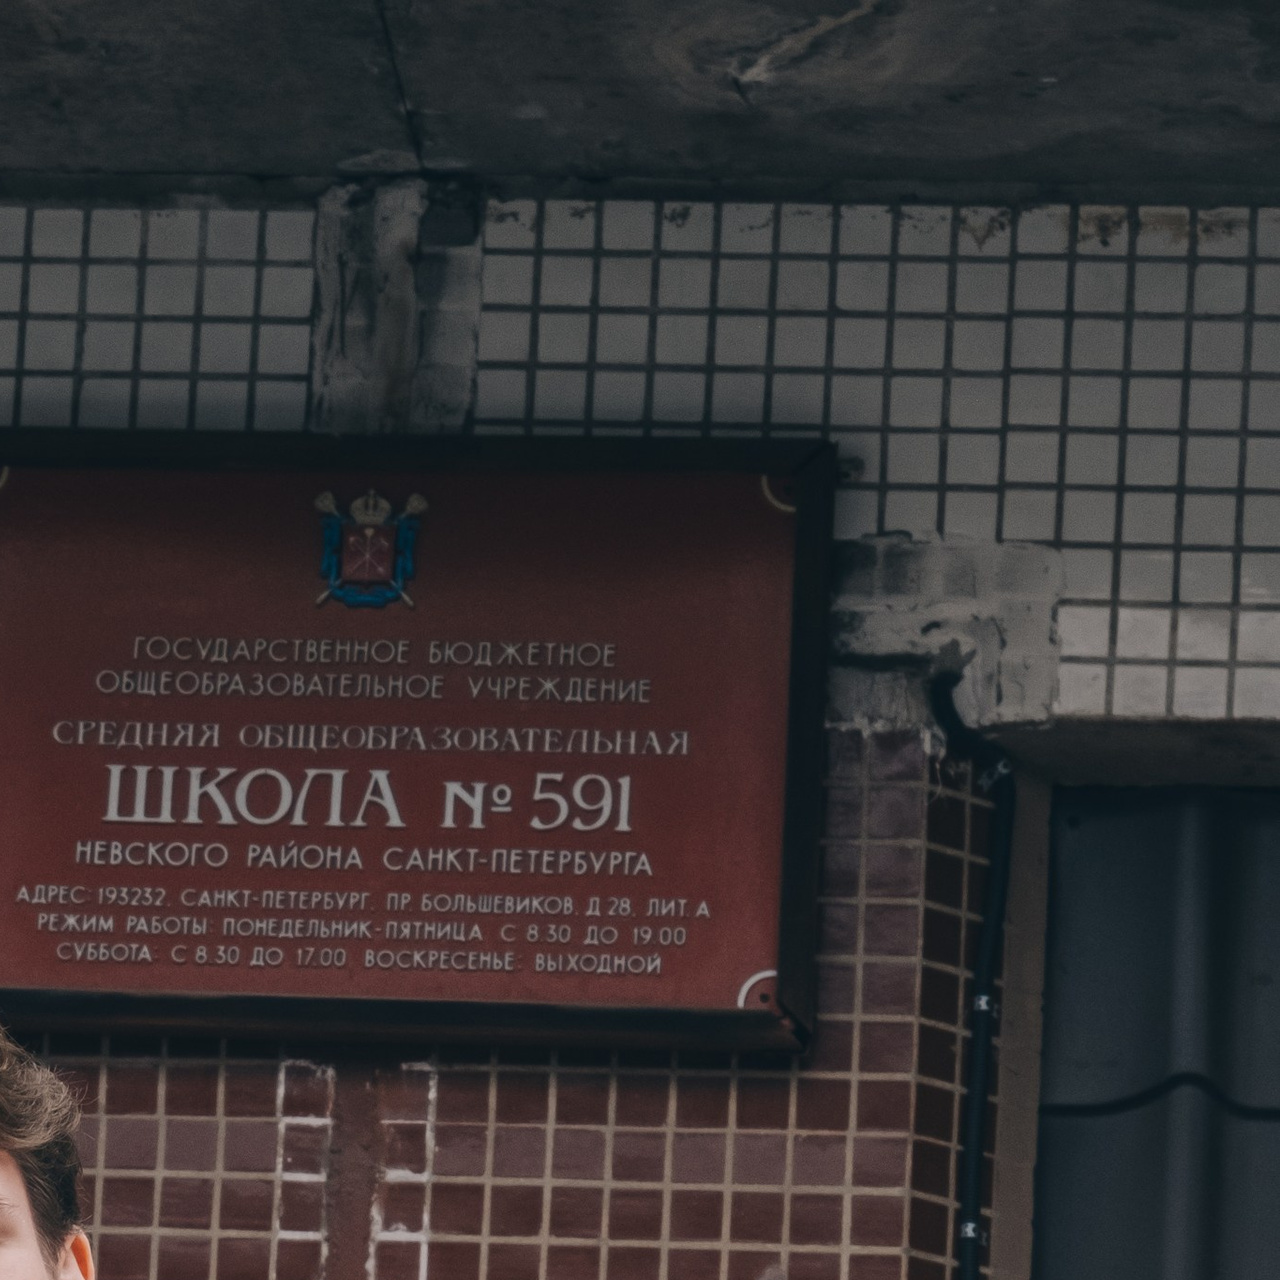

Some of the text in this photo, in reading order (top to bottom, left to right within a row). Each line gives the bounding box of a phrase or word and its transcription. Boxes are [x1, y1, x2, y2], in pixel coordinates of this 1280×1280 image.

[132, 636, 616, 667] ГОСУДАРСТВЕННОЕ БЮДЖЕТНОЕ
[95, 669, 651, 703] ОБЩЕОБРАЗОВАТЕЛЬНОЕ УЧРЕЖДЕНИЕ
[52, 720, 690, 755] СРЕДНЯЯ ОБЩЕОБРАЗОВАТЕЛЬНАЯ
[101, 763, 633, 832] ШКОЛА № 591
[75, 840, 653, 877] НЕВСКОГО РАЙОНА САНКТ-ПЕТЕРБУРГА
[695, 899, 712, 919] А
[36, 912, 115, 933] РЕЖИМ
[500, 924, 517, 942] С
[582, 925, 620, 946] ДО
[170, 945, 188, 964] С
[249, 945, 285, 967] ДО
[534, 951, 663, 974] ВЫХОДНОЙ
